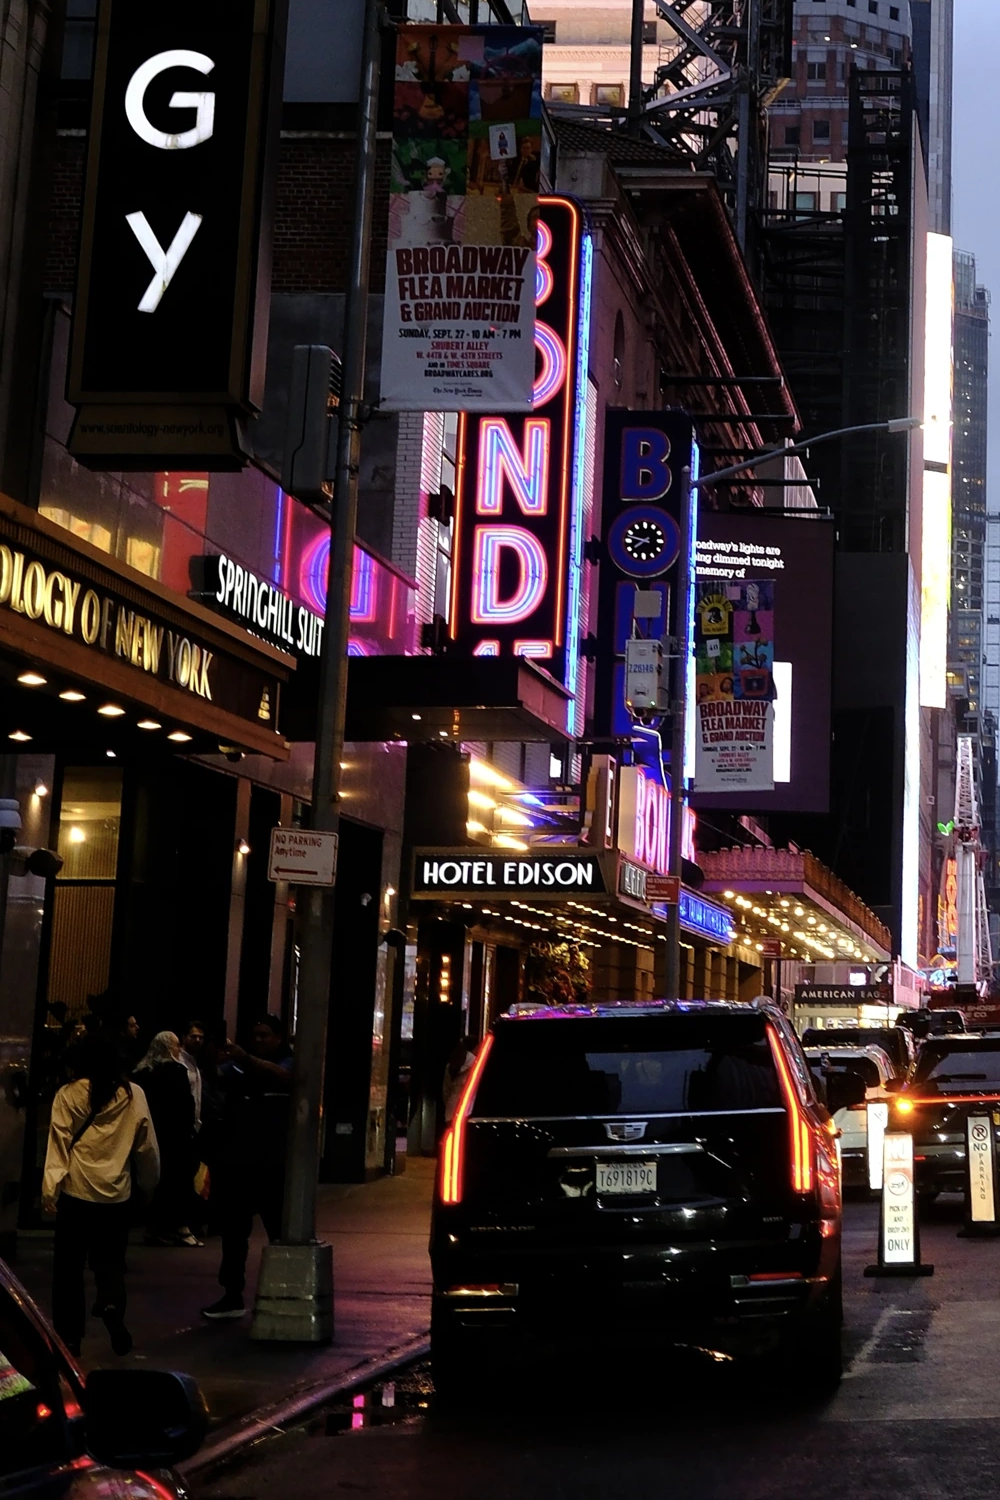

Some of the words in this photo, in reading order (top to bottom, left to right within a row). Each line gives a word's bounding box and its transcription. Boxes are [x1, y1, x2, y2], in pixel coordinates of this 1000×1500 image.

[396, 247, 530, 276] BROADWAY
[398, 276, 443, 301] FLEA
[446, 275, 525, 302] MARKET
[400, 303, 412, 323] &
[414, 302, 461, 321] GRAND
[463, 302, 521, 323] AUCTION
[399, 329, 431, 339] SUNDAY,
[433, 329, 453, 339] SEPT.
[483, 329, 495, 339] AM
[502, 329, 508, 339] 7
[509, 329, 521, 339] PM
[431, 341, 465, 351] SHUBERT
[466, 341, 489, 351] ALLEY
[424, 370, 494, 378] BROADWAYCARES.ORG
[739, 542, 764, 554] lights
[765, 546, 781, 556] are
[713, 553, 751, 566] dimmed
[752, 557, 785, 569] tonight
[696, 566, 734, 579] memory
[735, 568, 746, 578] of
[216, 554, 294, 645] SPRINGHILL
[296, 606, 325, 658] SUIT
[115, 605, 164, 674] NEW
[167, 630, 214, 701] YORK
[699, 701, 769, 718] BROADWAY
[701, 718, 724, 732] FLEA
[725, 716, 767, 730] MARKET
[709, 731, 733, 743] GRAND
[734, 731, 765, 742] AUCTION
[275, 833, 286, 844] NO
[288, 835, 322, 847] PARKING
[275, 846, 307, 858] Anytime
[424, 861, 497, 885] HOTEL
[503, 862, 593, 886] EDISON
[801, 990, 855, 999] AMERICAN
[974, 1143, 988, 1152] NO
[600, 1169, 653, 1187] T691819C
[888, 1238, 910, 1251] ONLY
